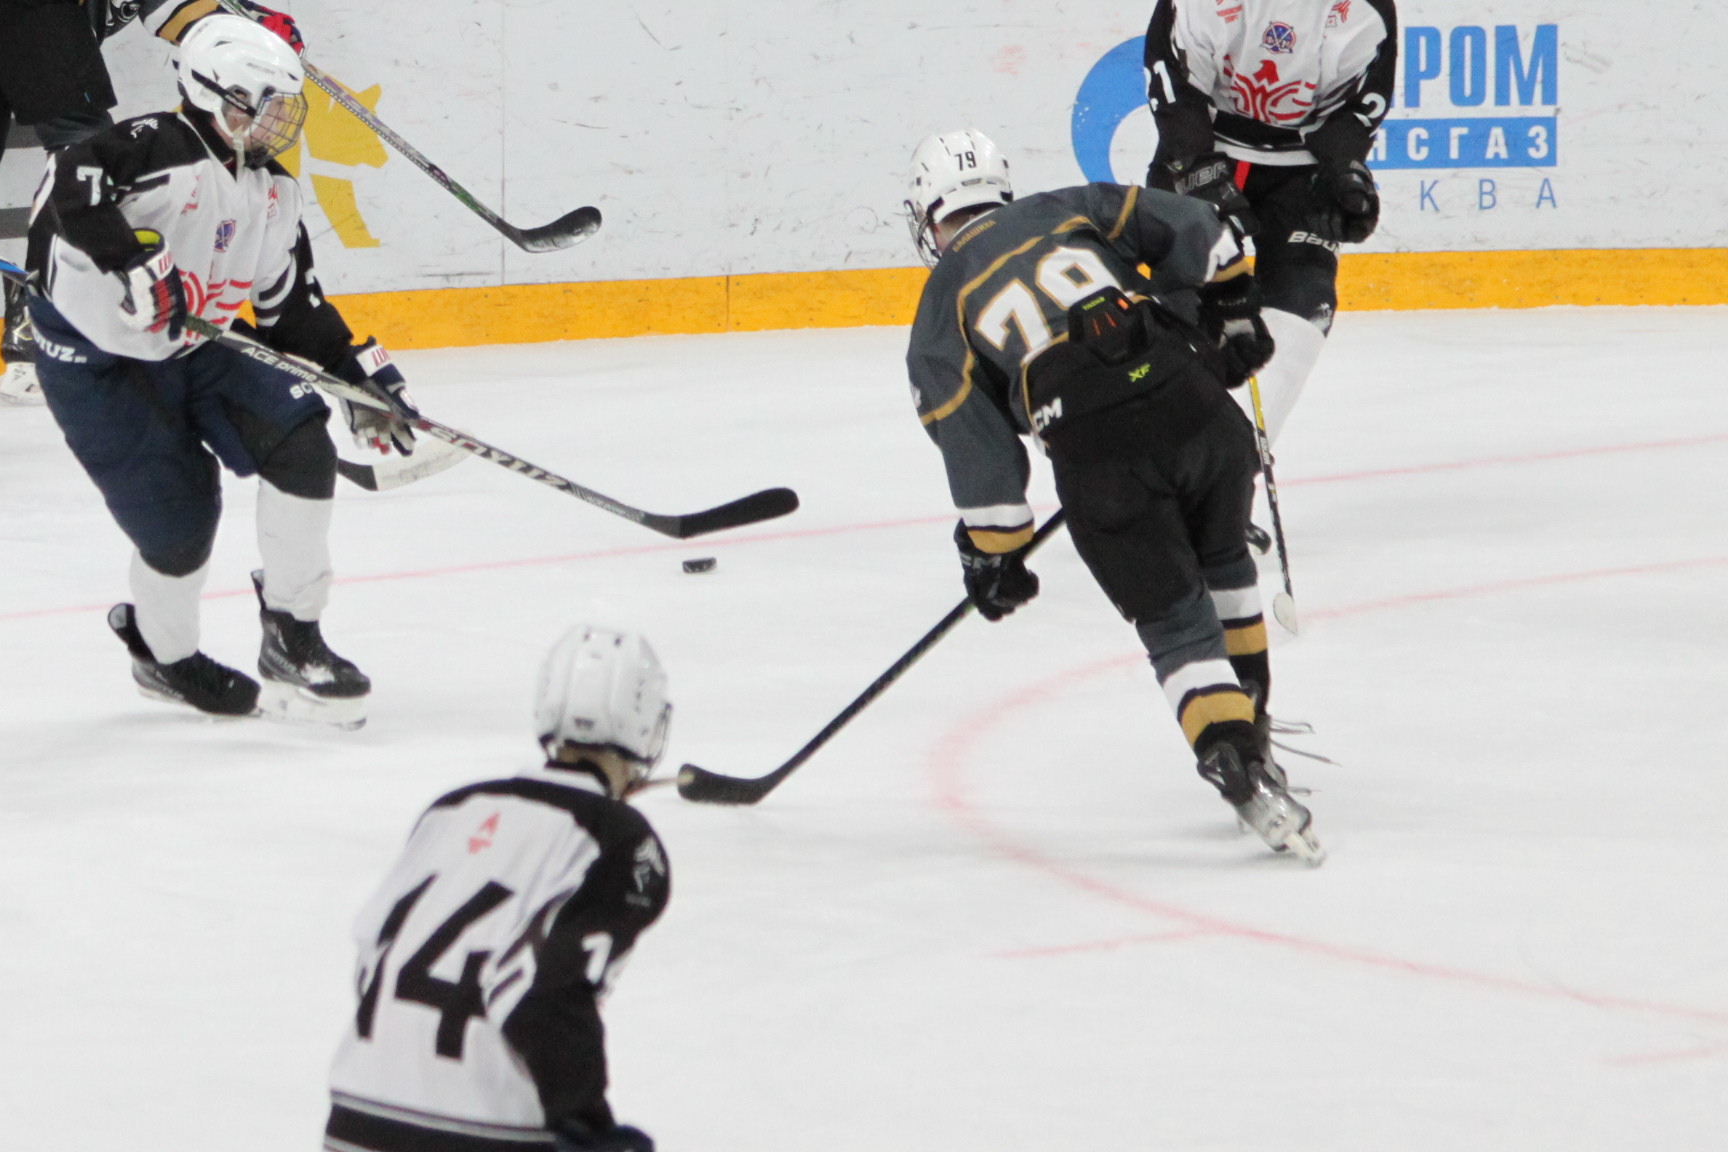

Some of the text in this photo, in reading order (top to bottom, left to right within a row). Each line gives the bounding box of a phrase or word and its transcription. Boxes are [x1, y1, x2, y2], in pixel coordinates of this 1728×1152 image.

[954, 151, 977, 172] 79
[974, 245, 1124, 354] 79
[240, 346, 280, 366] ACE
[1032, 397, 1064, 434] CM
